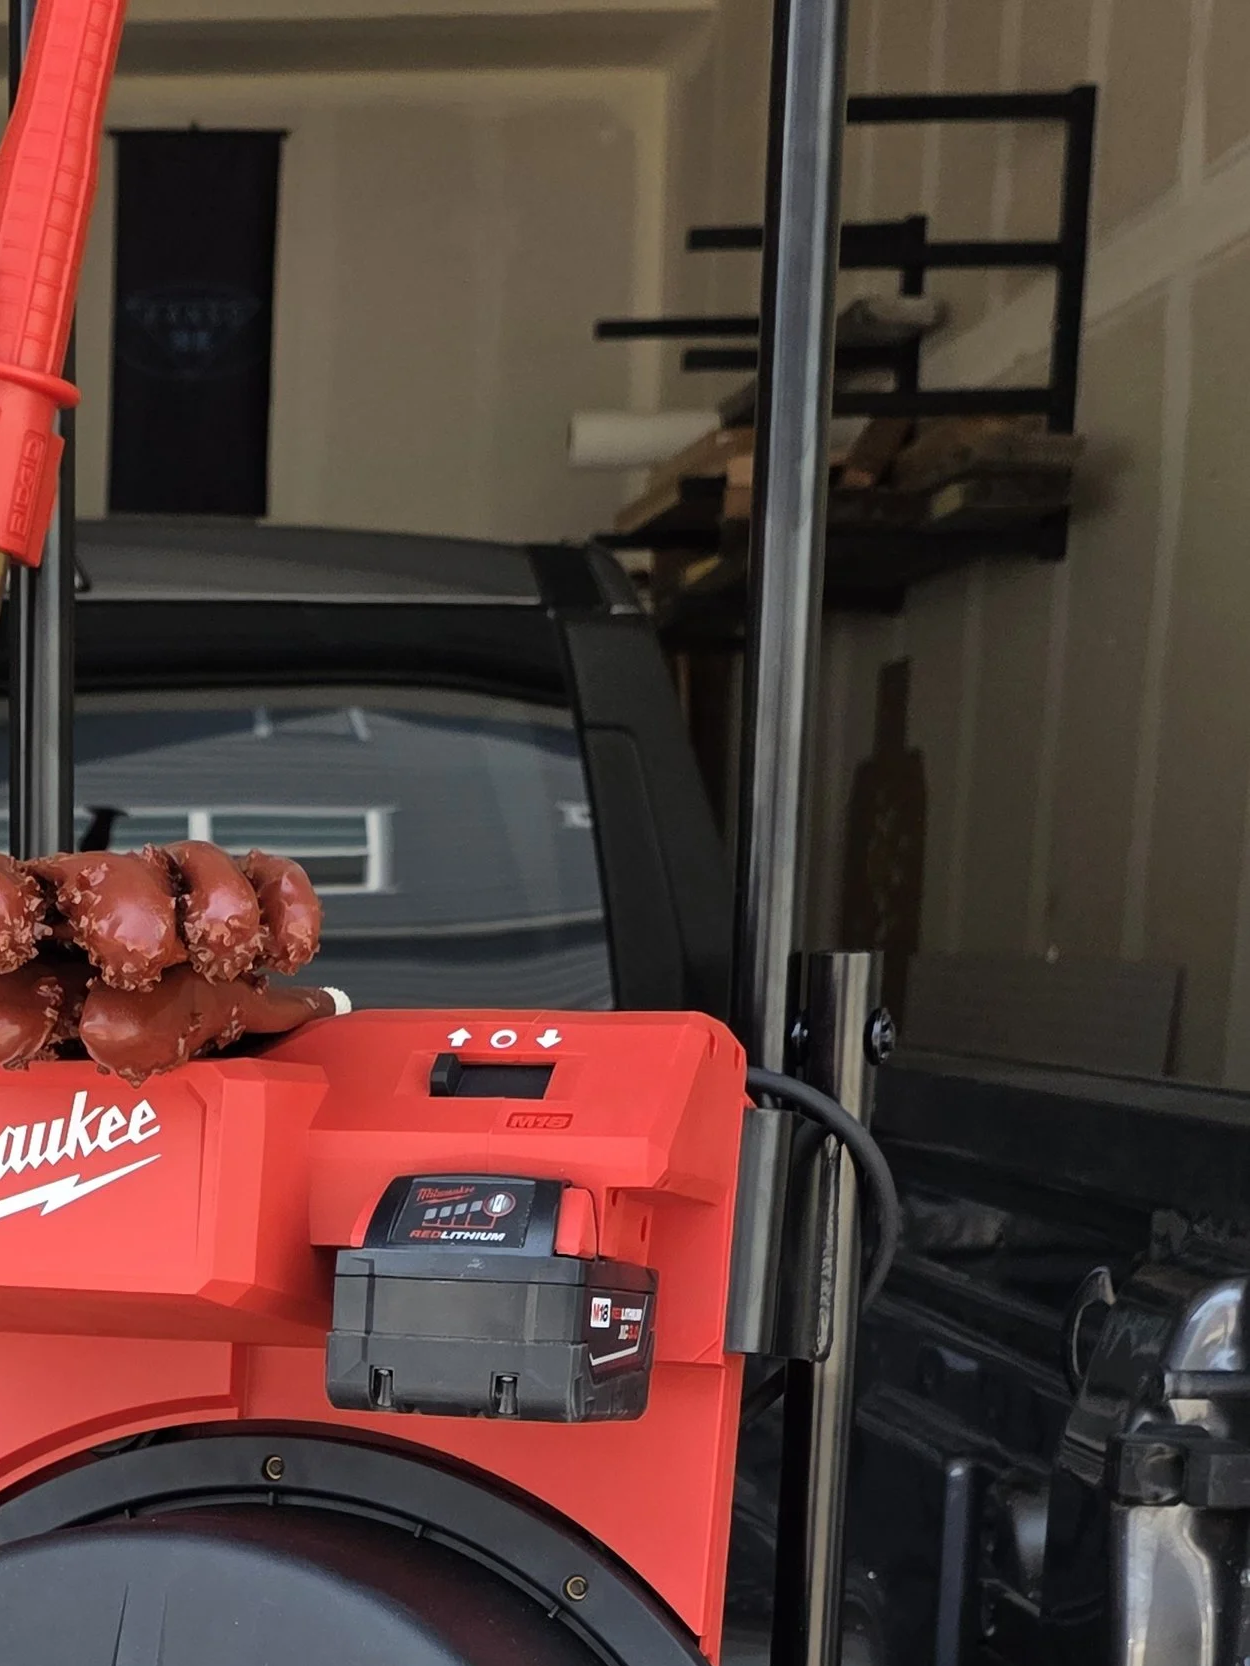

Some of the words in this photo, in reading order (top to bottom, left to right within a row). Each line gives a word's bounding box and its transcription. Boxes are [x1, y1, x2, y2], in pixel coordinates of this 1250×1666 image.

[510, 1114, 571, 1129] M18
[409, 1229, 507, 1242] REDLITHIUM
[592, 1303, 609, 1323] M18
